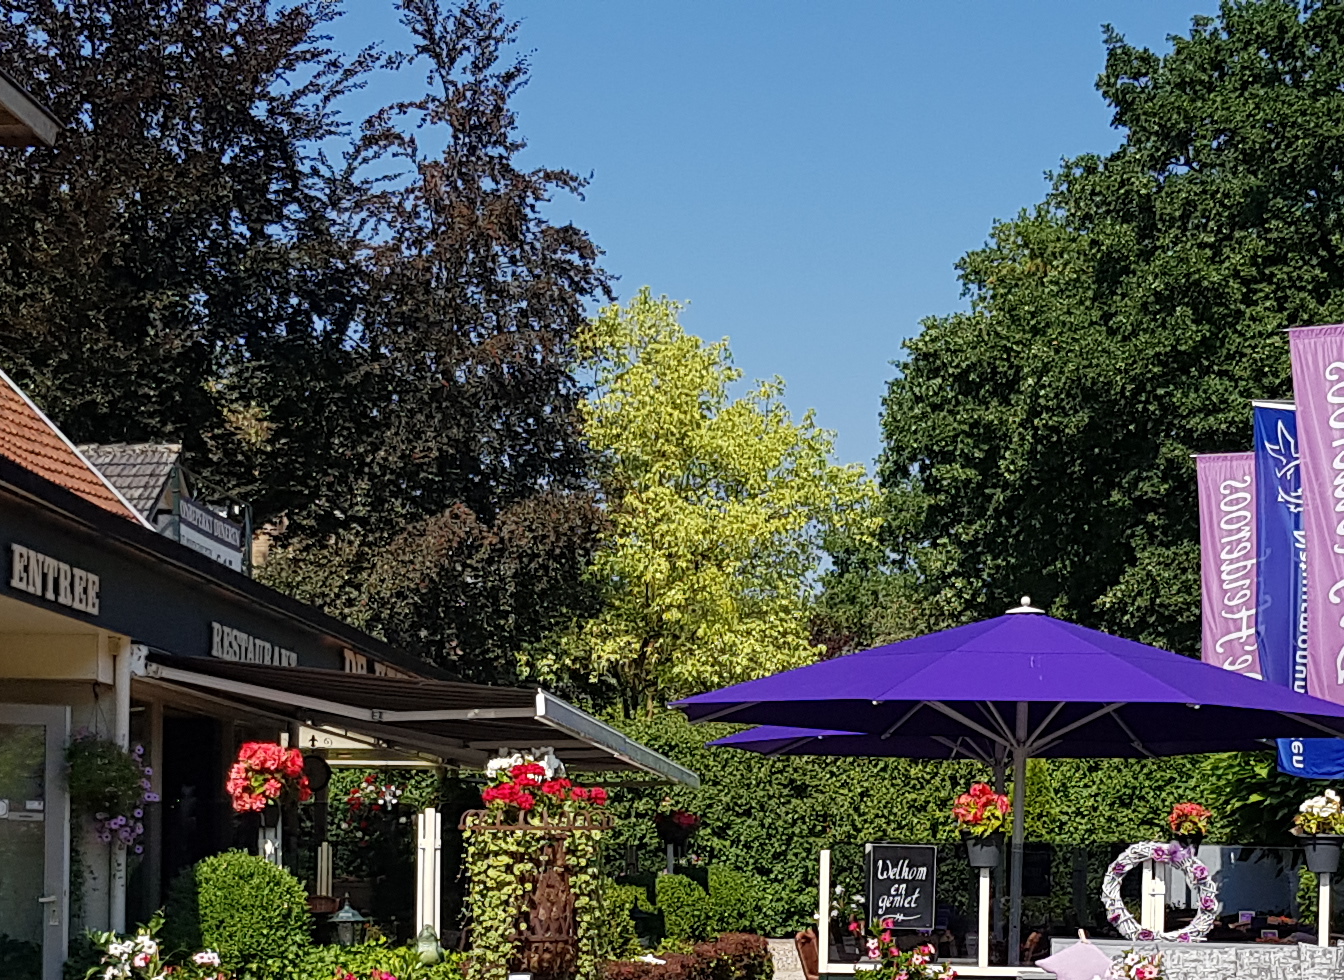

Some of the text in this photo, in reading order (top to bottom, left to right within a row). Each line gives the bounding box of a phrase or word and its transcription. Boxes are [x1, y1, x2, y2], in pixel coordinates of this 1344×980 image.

[10, 542, 100, 616] ENTREE
[877, 859, 927, 880] Welkom
[878, 887, 920, 915] geniet
[890, 883, 906, 895] en
